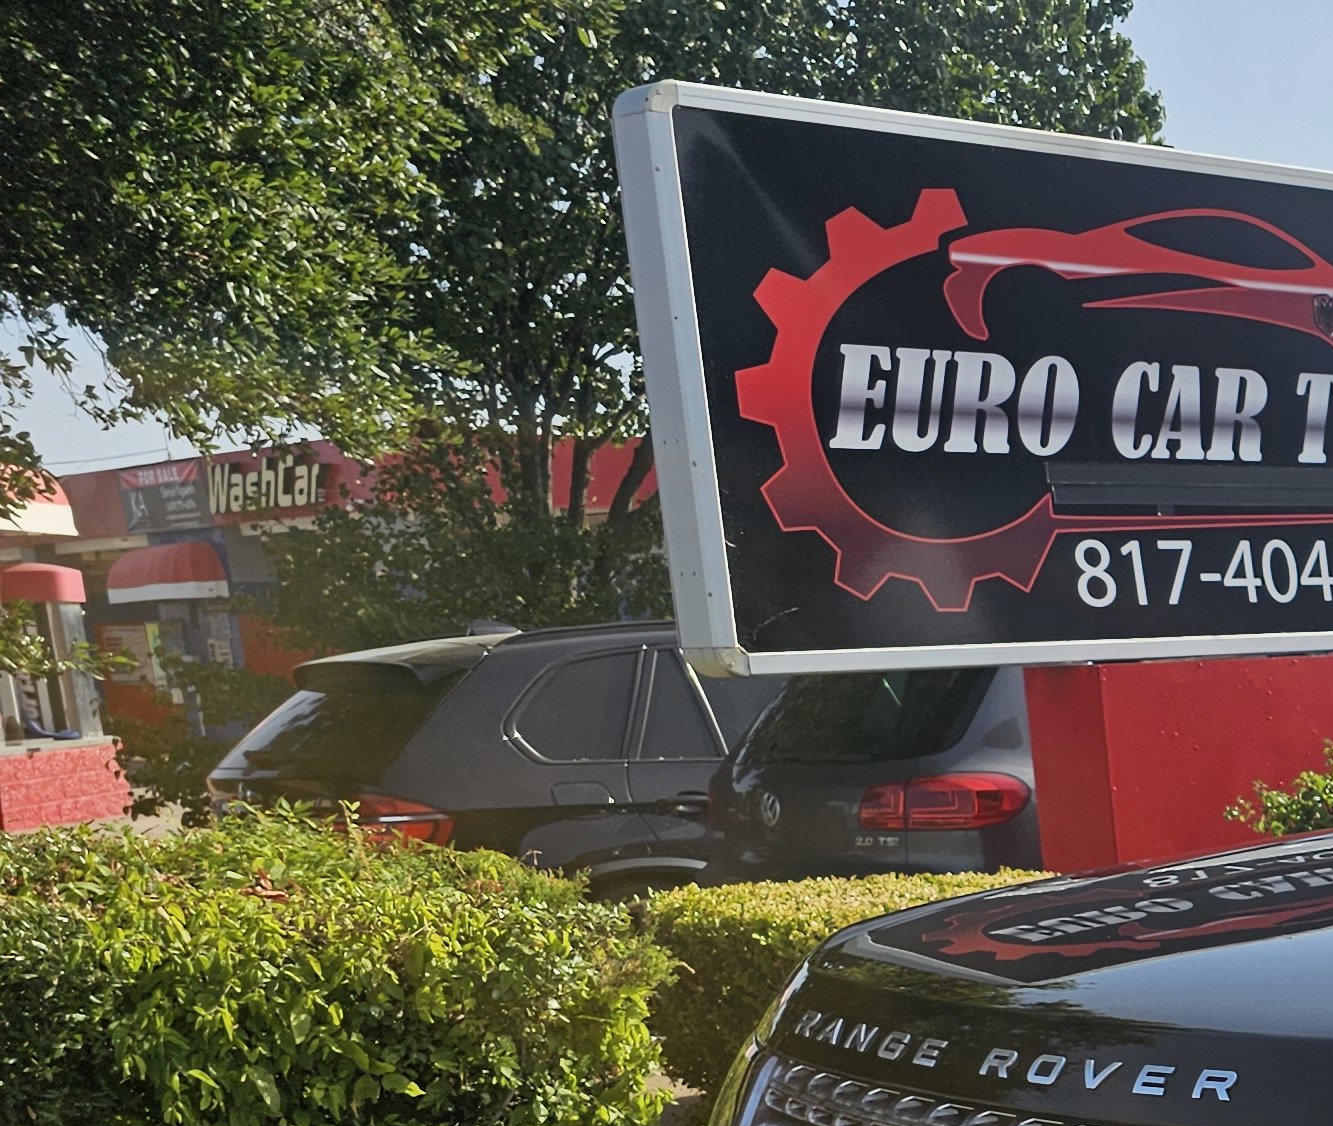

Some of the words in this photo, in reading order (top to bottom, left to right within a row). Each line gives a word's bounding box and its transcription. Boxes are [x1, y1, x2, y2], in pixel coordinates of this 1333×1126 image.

[828, 343, 1080, 457] EURO
[1111, 360, 1269, 462] CAR
[156, 466, 180, 484] SALE
[794, 1009, 948, 1068] RANGE
[978, 1047, 1238, 1101] ROVER
